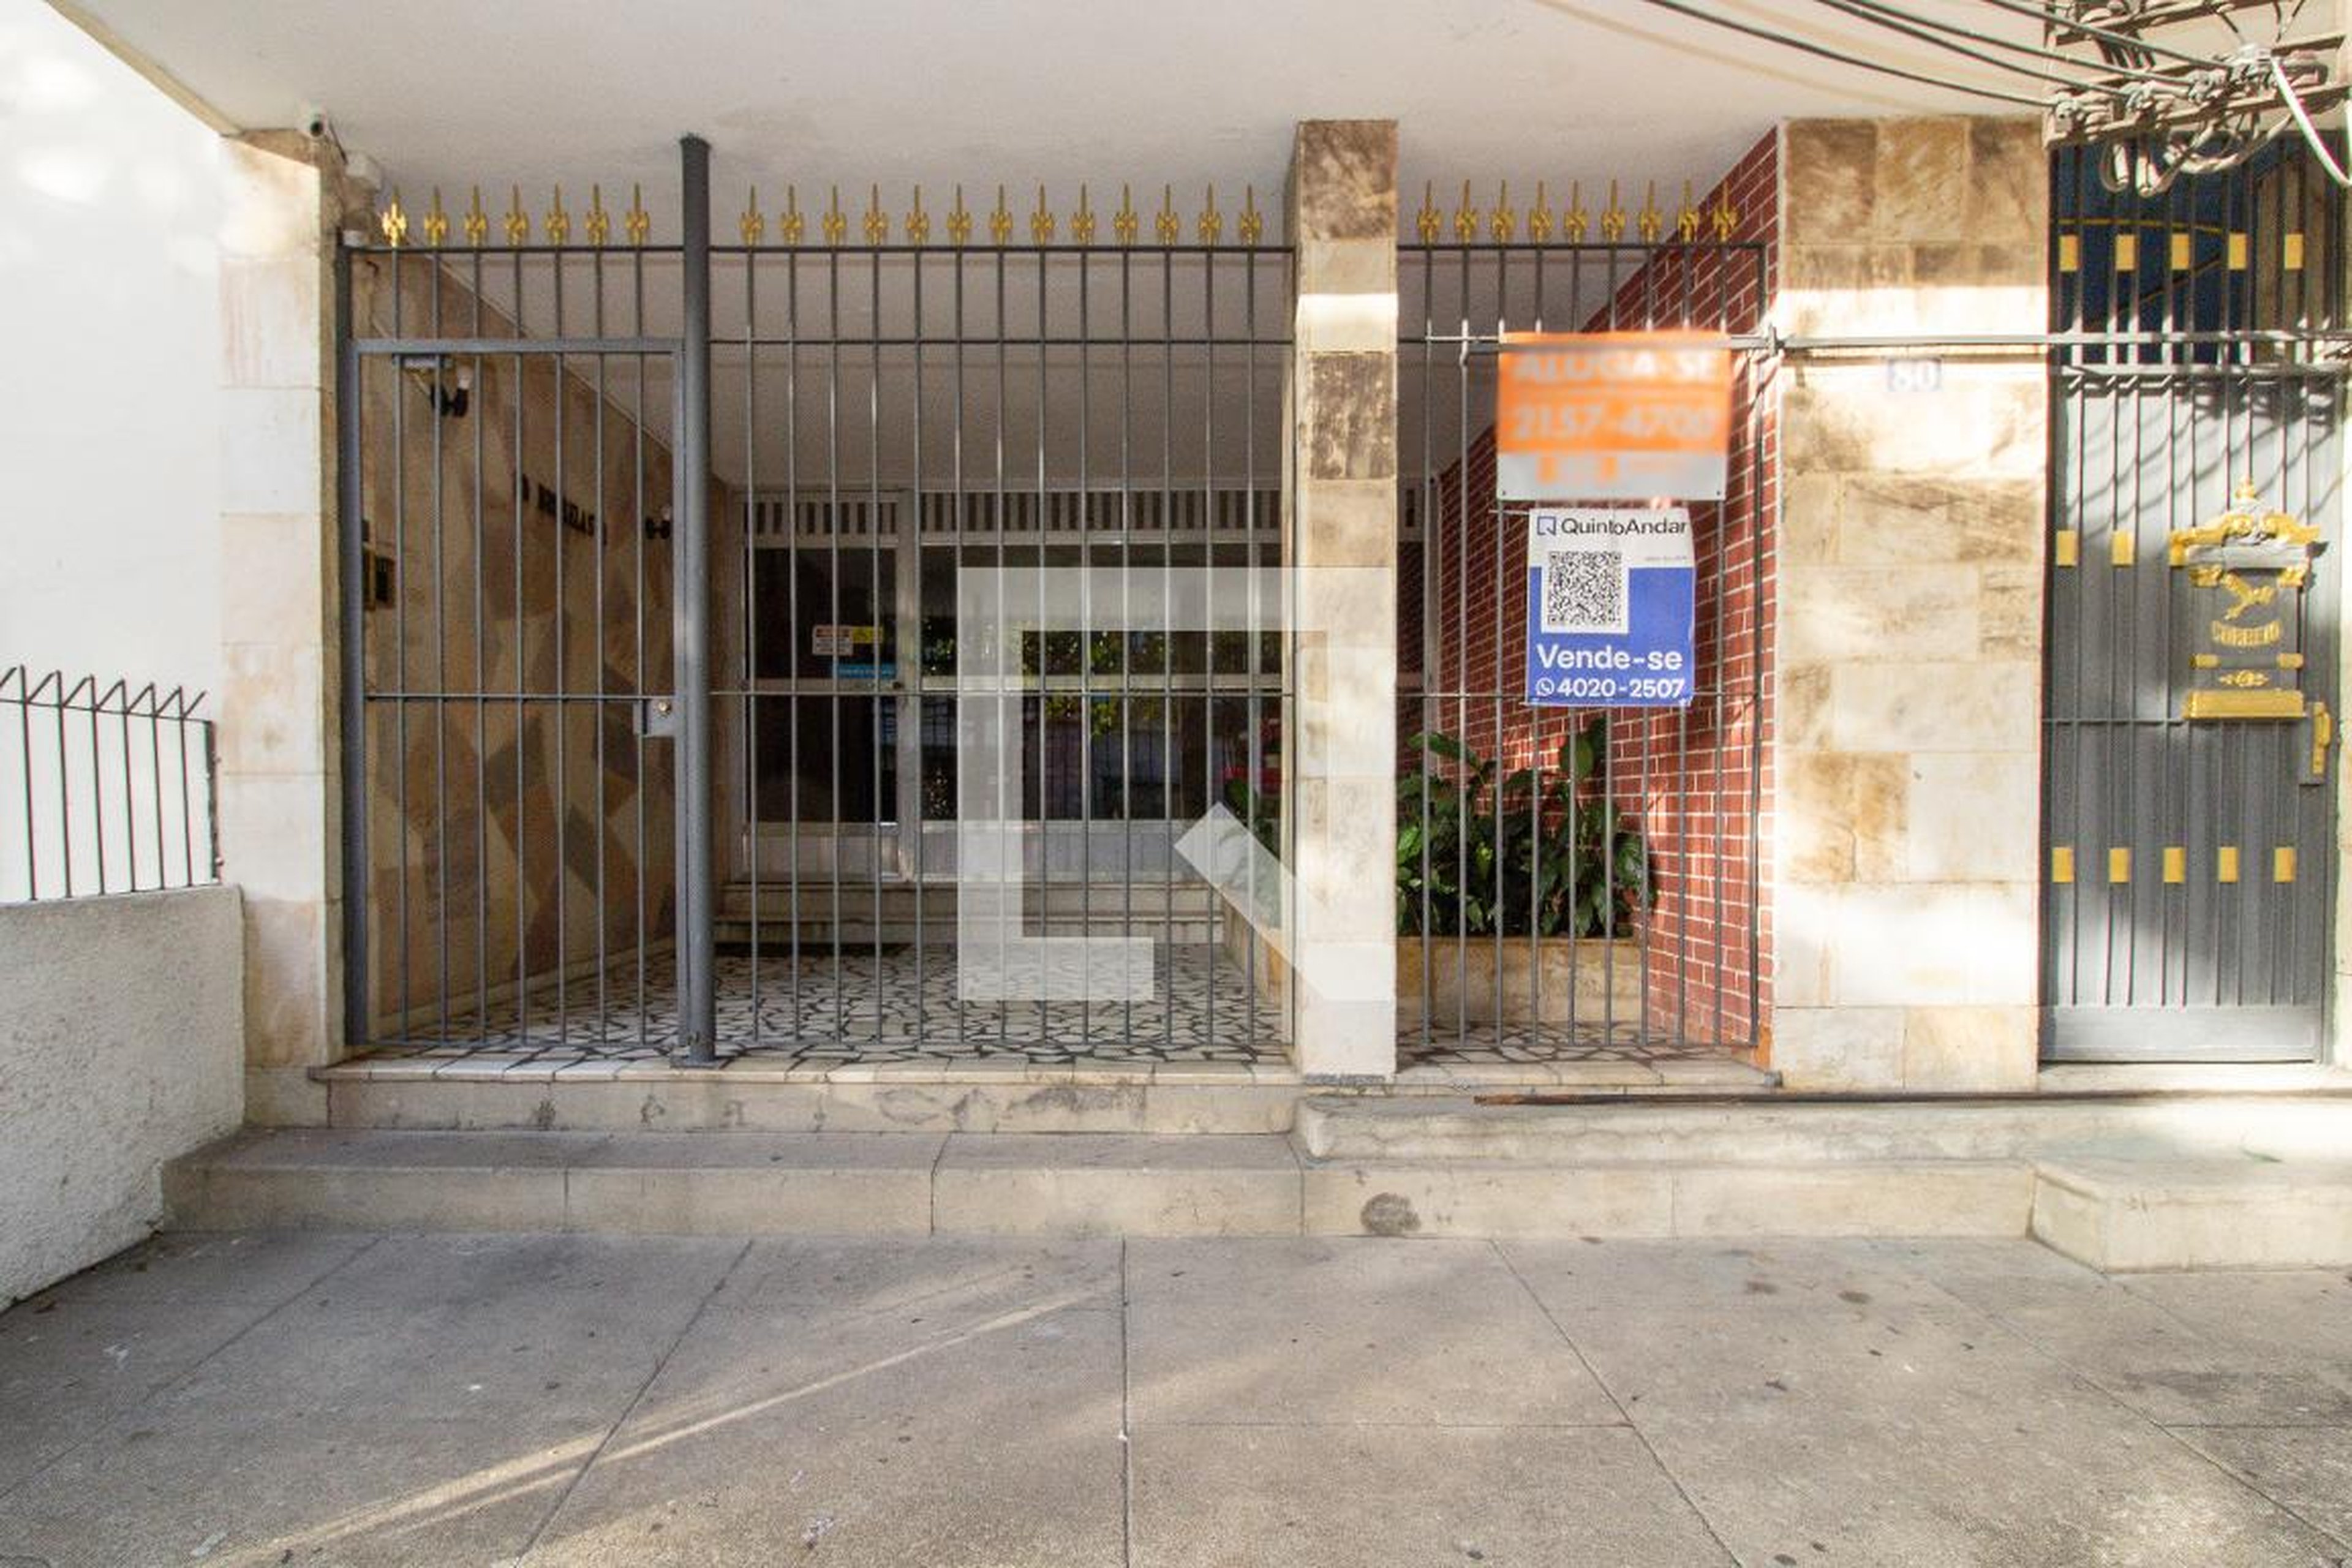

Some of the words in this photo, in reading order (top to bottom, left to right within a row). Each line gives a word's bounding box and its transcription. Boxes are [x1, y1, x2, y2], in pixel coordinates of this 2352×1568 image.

[1561, 517, 1687, 535] QuintoAndar
[1537, 644, 1683, 670] Vende-se
[1557, 678, 1685, 698] 4020-2507
